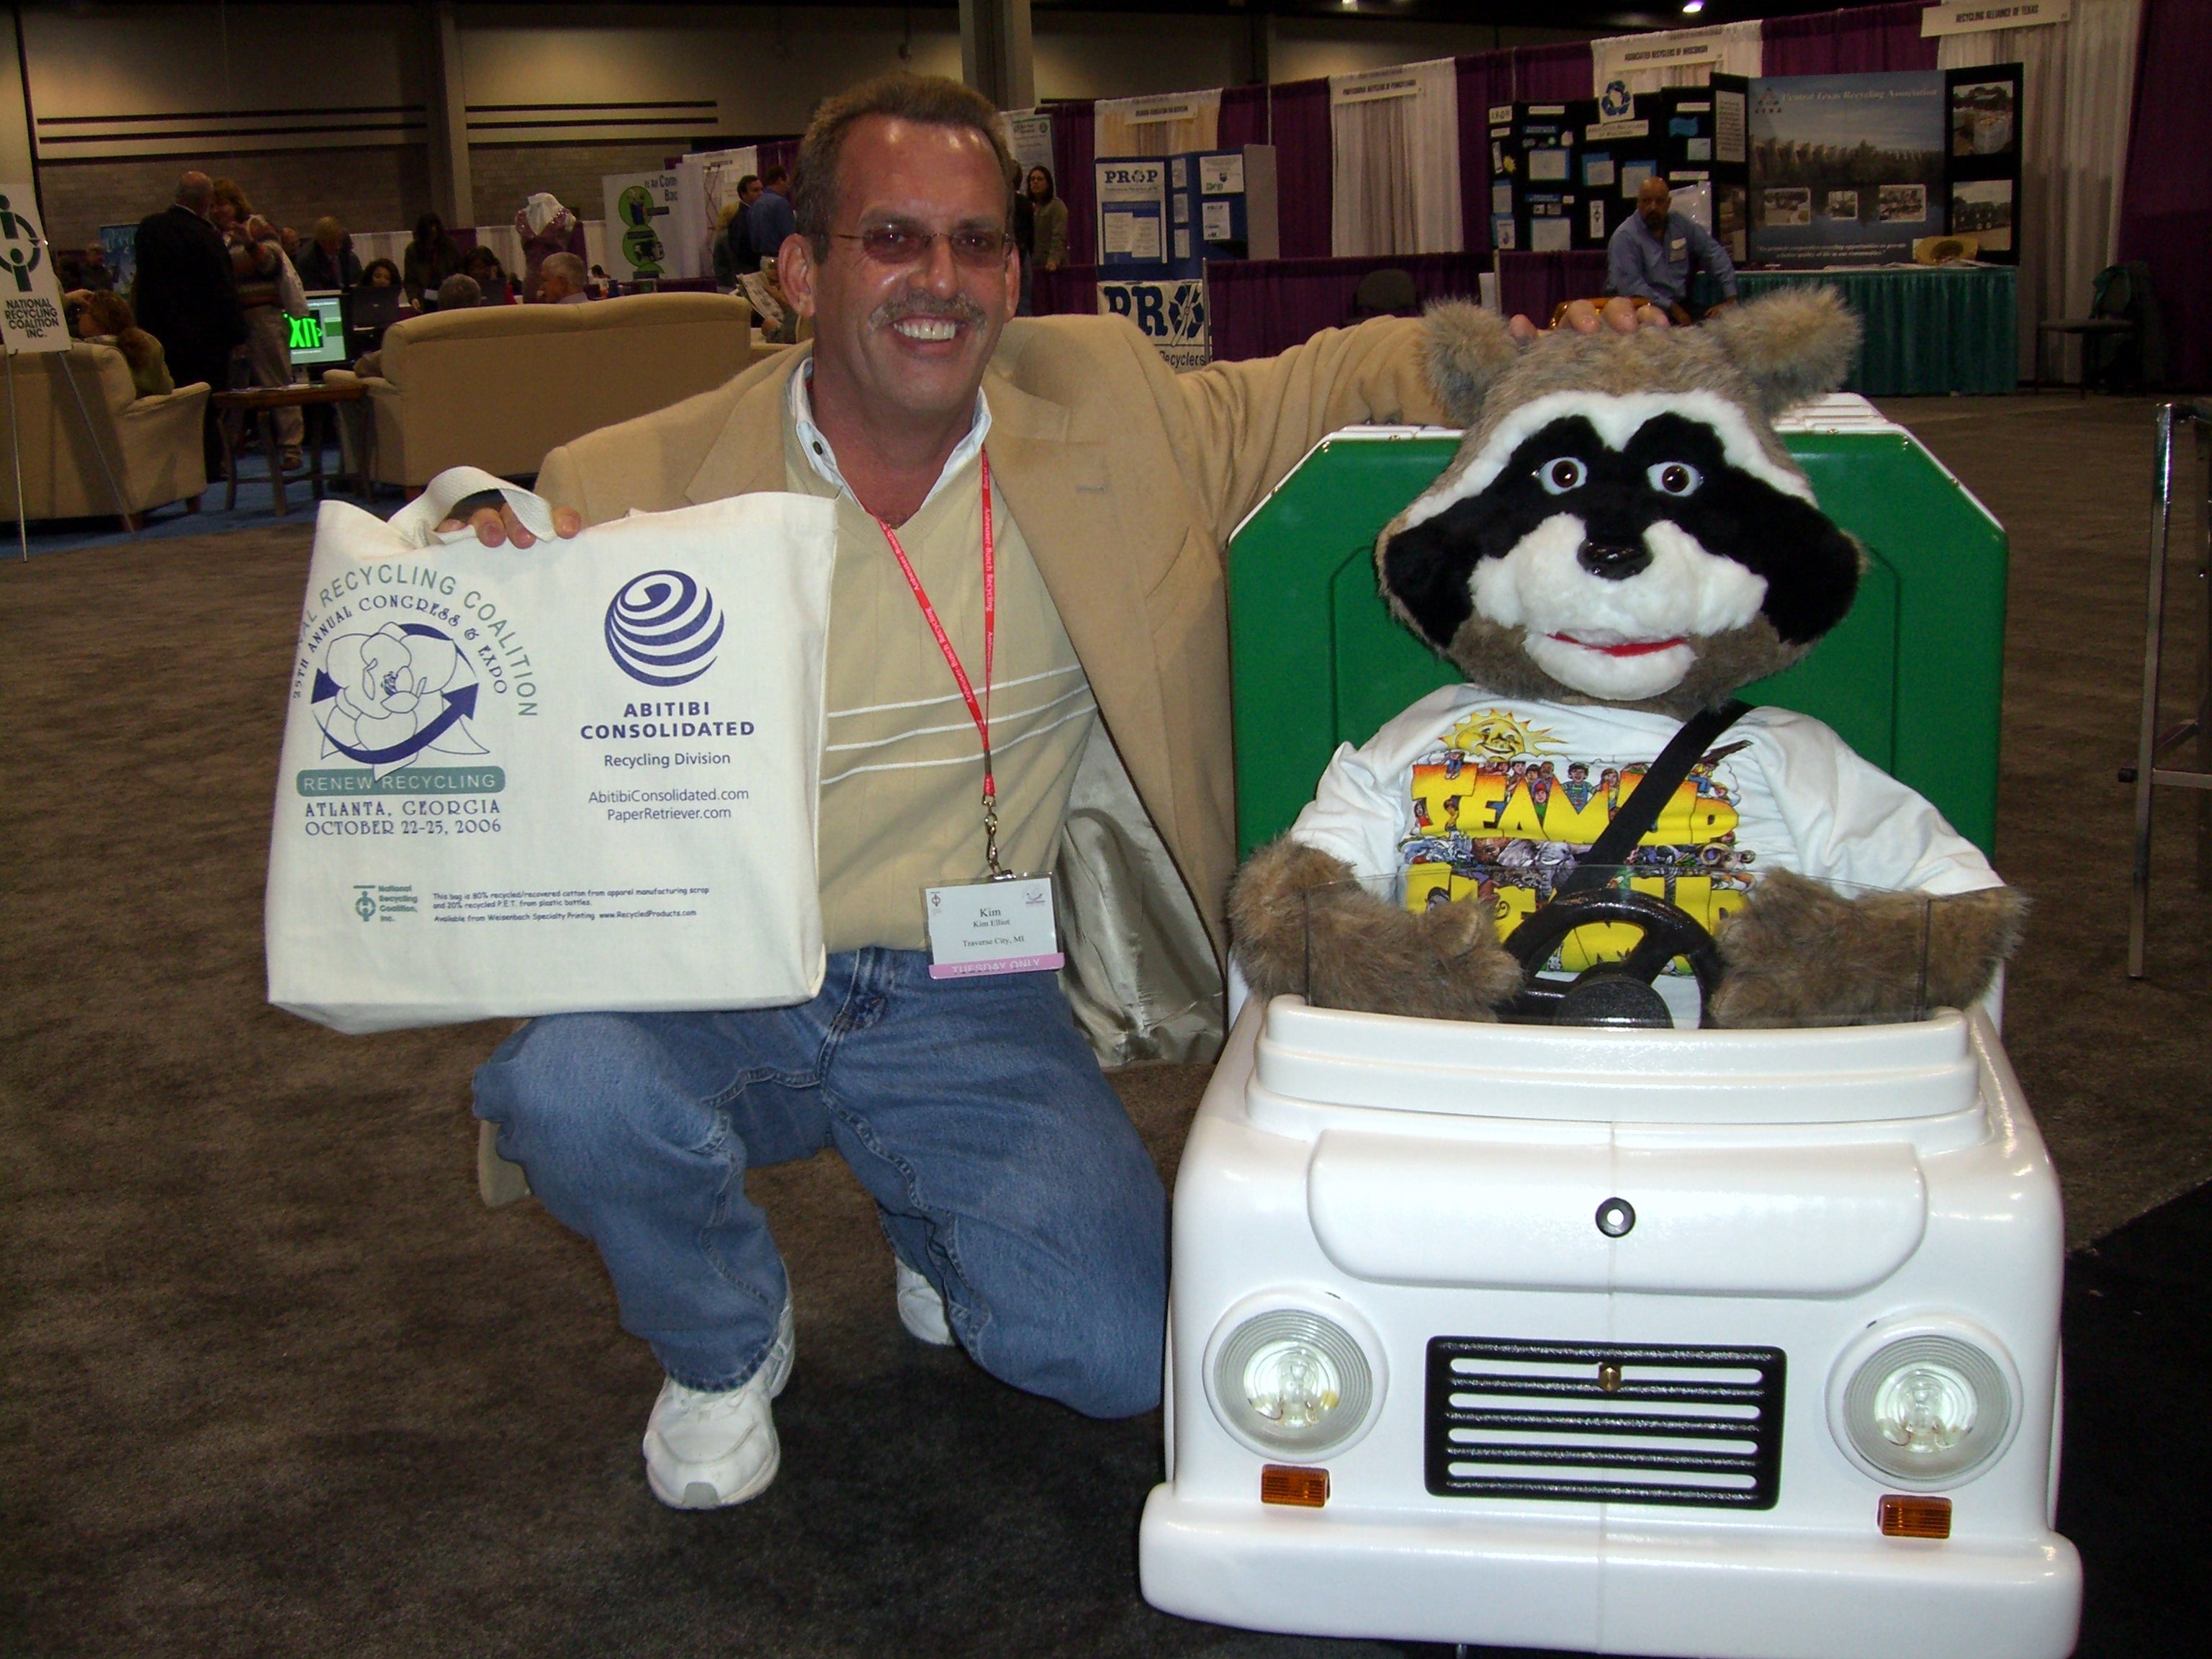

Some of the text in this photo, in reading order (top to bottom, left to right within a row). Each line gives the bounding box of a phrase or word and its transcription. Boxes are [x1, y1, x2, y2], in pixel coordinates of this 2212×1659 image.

[6, 297, 52, 310] NATIONAL
[4, 307, 58, 320] RECYCLING
[9, 318, 59, 330] COALITION
[27, 328, 48, 338] INC.
[307, 606, 353, 652] ANNUAL
[359, 595, 461, 626] CONGRESS
[464, 627, 480, 641] &
[477, 645, 507, 694] EXPO
[320, 564, 457, 608] RECYCLING
[464, 590, 537, 716] COALITION
[623, 701, 710, 717] ABITIBI
[580, 721, 755, 739] CONSOLIDATED
[604, 752, 731, 769] Recycling Division
[304, 773, 496, 791] RENEW RECYCLING
[588, 788, 749, 804] AbitibiConsolidated.com
[305, 799, 500, 817] ATLANTA, GEORGIA
[1411, 763, 1611, 845] TEAM
[607, 807, 732, 823] PaperRetriever.com
[305, 819, 502, 836] OCTOBER 22-25, 2006
[379, 895, 418, 904] Recycling
[449, 893, 462, 902] bag
[490, 889, 561, 901] recycled/recovered
[607, 888, 634, 898] apparel
[636, 887, 688, 896] manufacturing
[464, 901, 495, 910] recycled
[979, 908, 1002, 917] Kim
[532, 912, 565, 921] Specialty
[567, 912, 595, 920] Printing
[599, 909, 697, 918] www.RecycledProducts.com
[963, 938, 993, 948] Traverse
[951, 962, 1006, 974] TUESDAY
